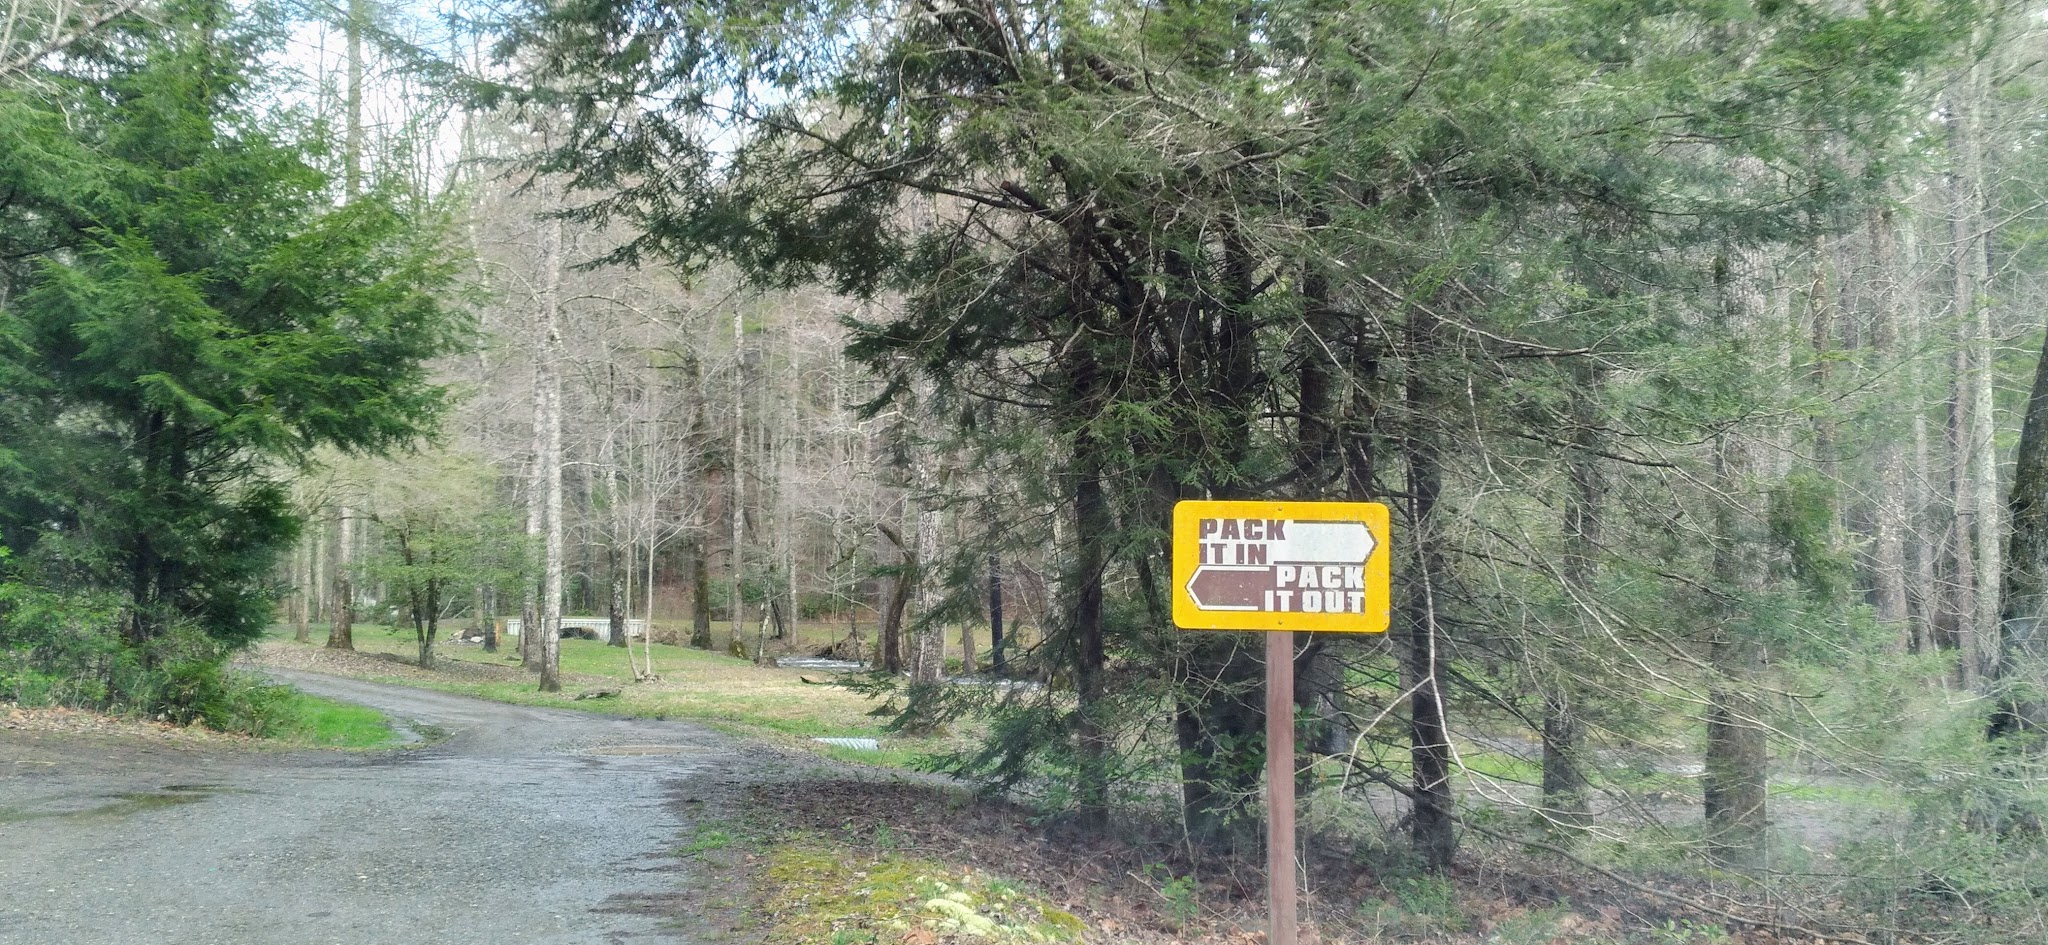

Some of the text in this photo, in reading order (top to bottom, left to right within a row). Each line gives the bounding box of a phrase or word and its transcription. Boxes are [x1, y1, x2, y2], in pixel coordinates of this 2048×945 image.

[1199, 518, 1286, 541] PACK
[1199, 543, 1267, 565] IT IN
[1276, 566, 1365, 589] PACK
[1264, 590, 1365, 614] IT OUT
